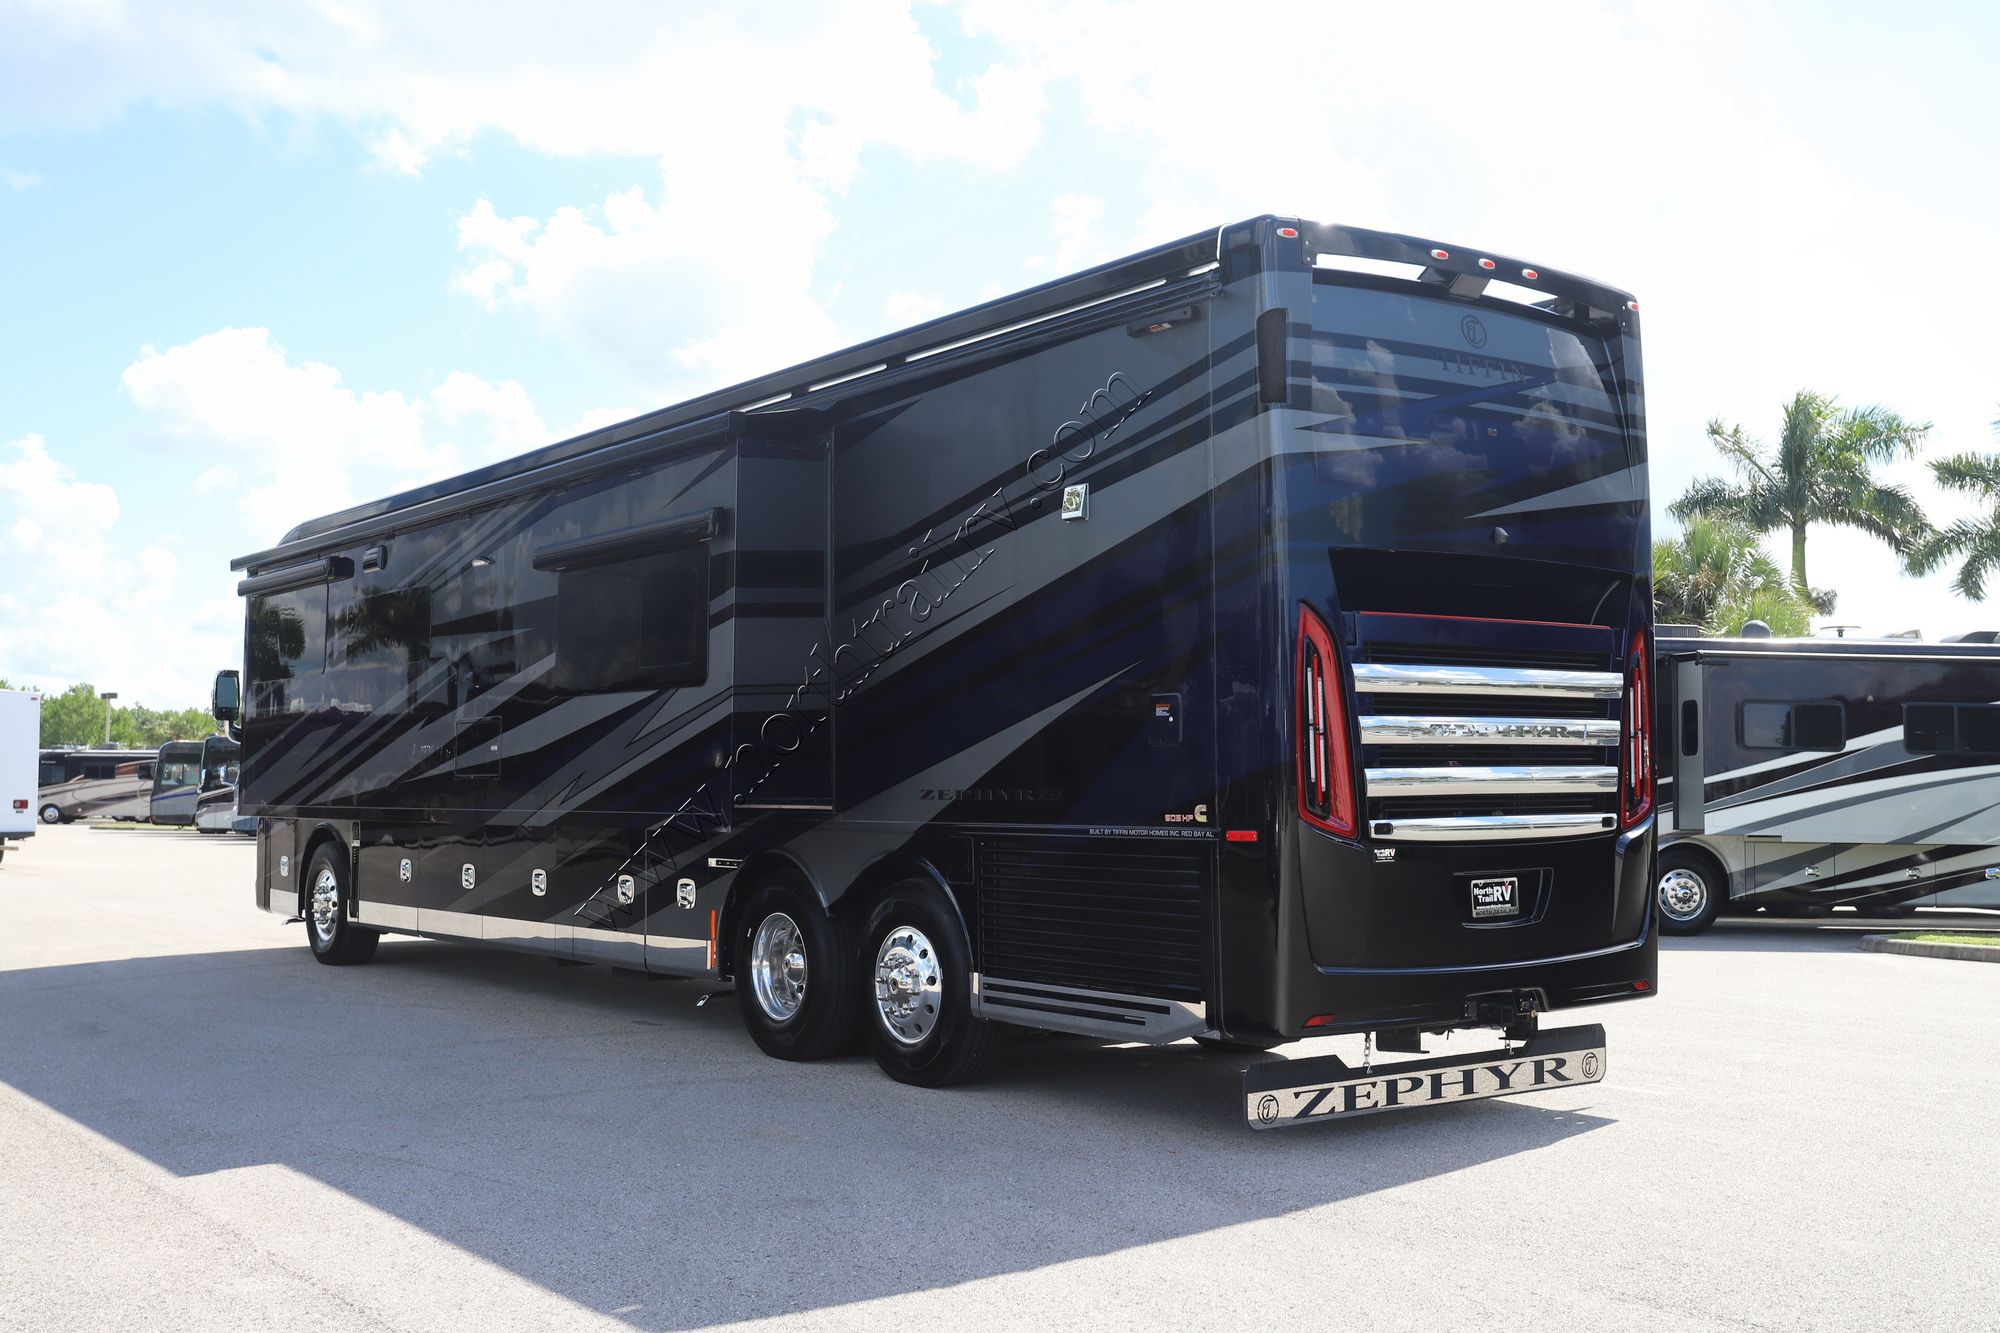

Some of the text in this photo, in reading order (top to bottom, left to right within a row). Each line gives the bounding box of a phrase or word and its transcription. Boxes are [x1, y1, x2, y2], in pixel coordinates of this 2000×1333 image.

[1436, 351, 1529, 384] TIFFIN
[1429, 723, 1572, 738] ZEPHYR
[1474, 886, 1493, 896] North
[1477, 894, 1493, 903] Trail
[1493, 884, 1512, 902] RV
[1293, 1057, 1574, 1120] ZEPHYR
